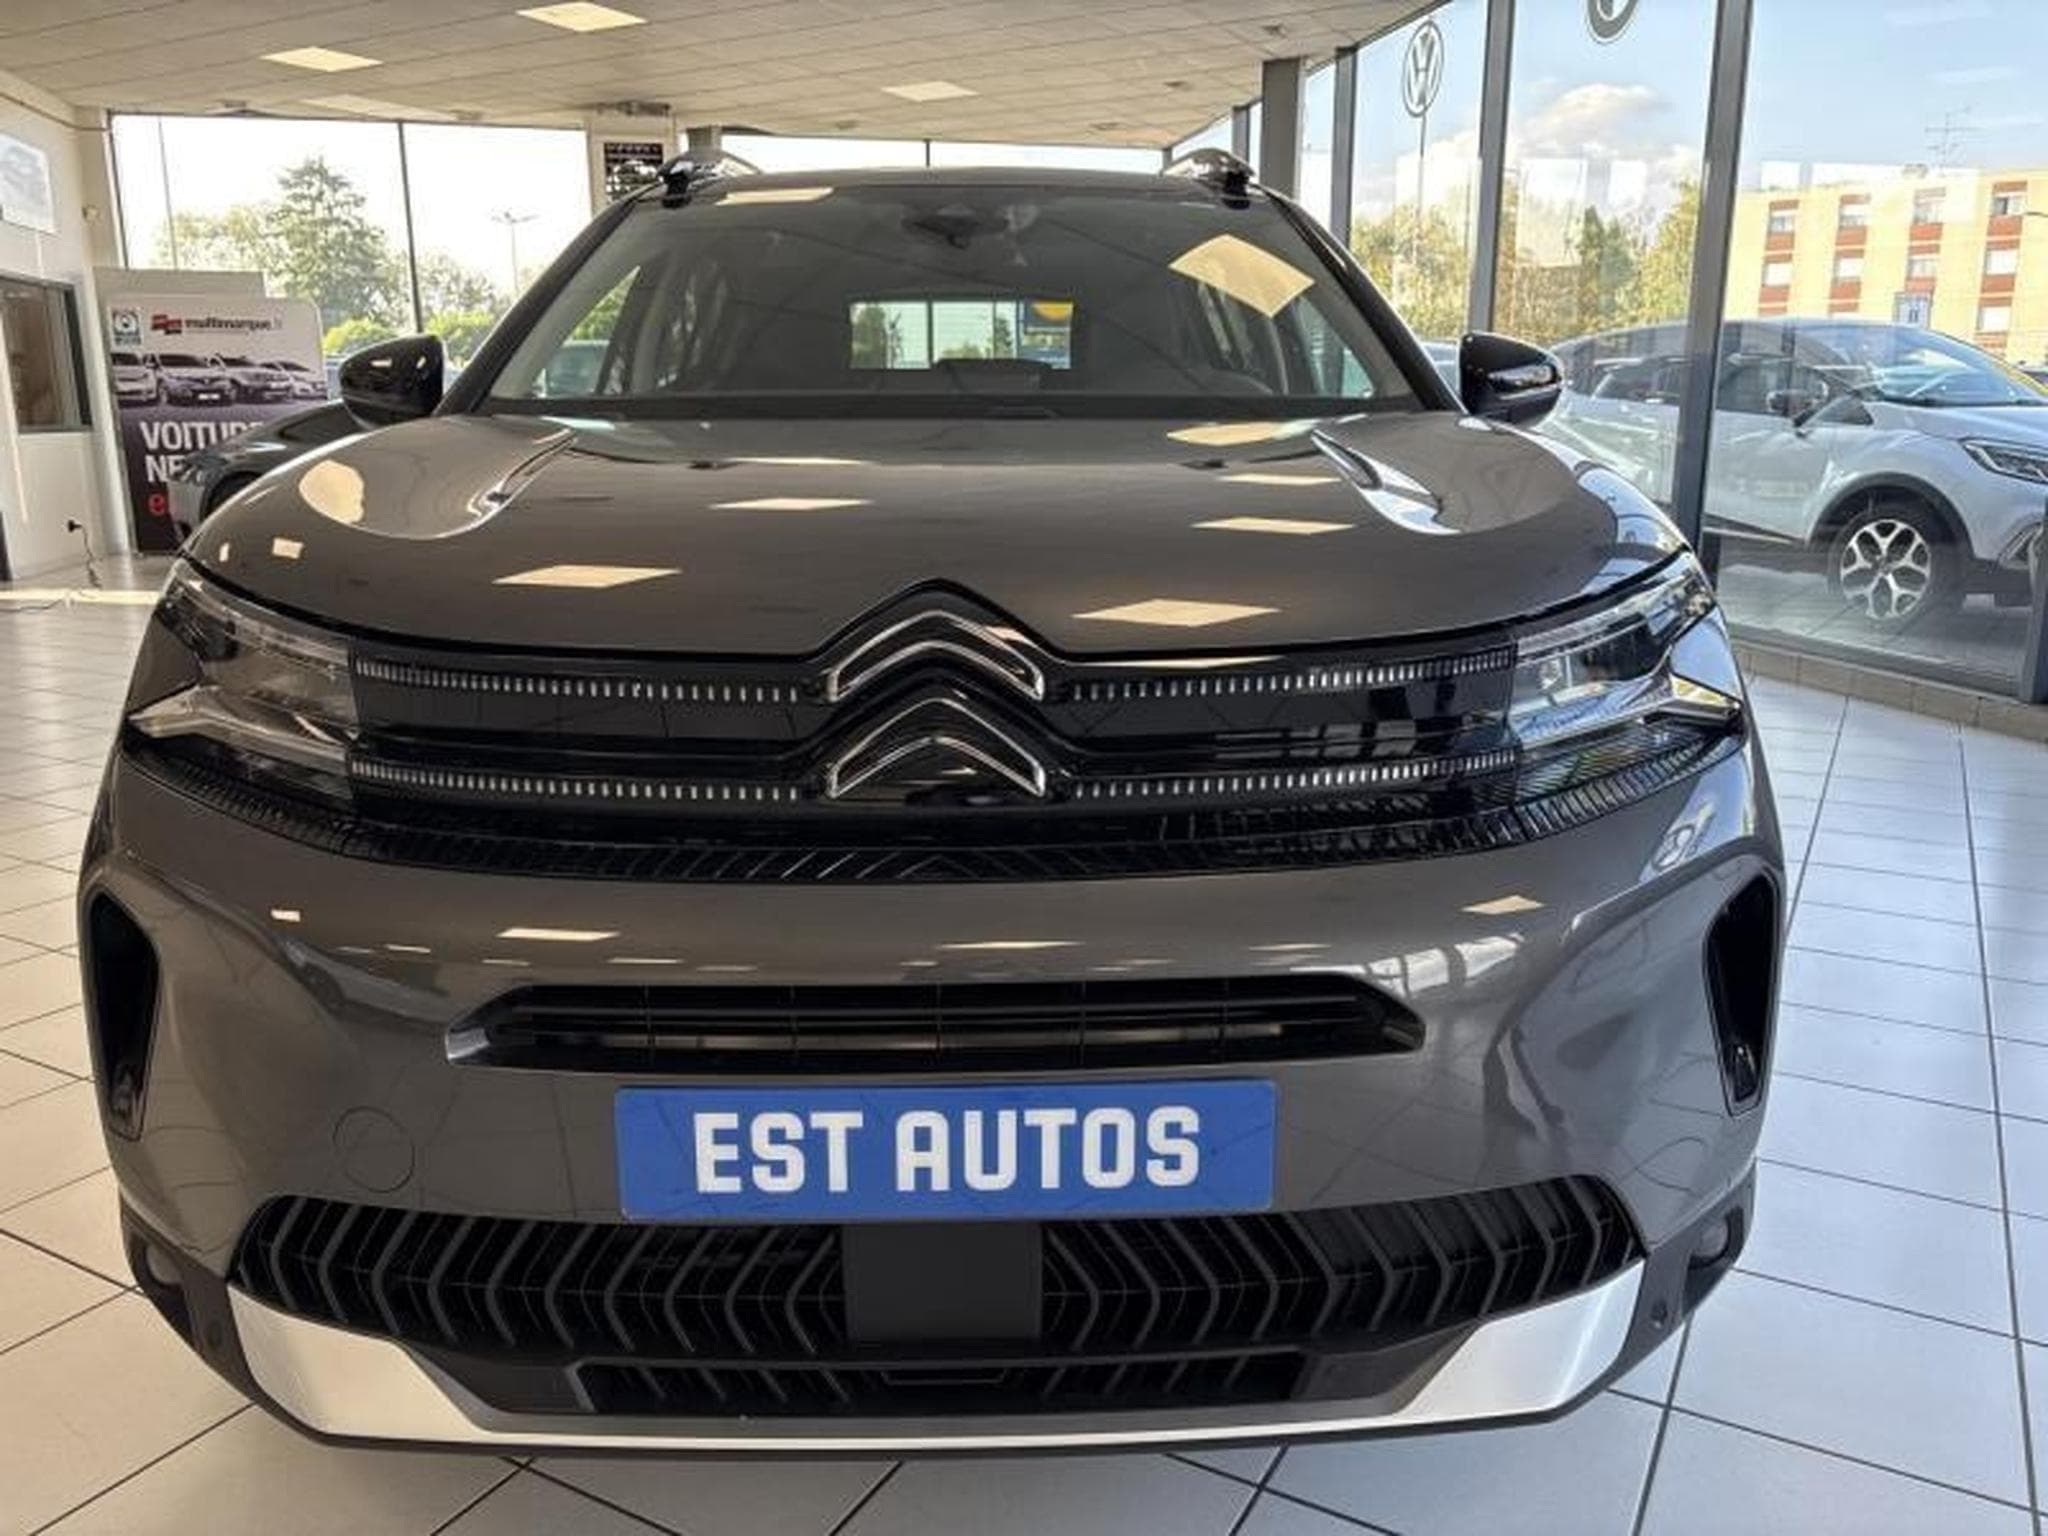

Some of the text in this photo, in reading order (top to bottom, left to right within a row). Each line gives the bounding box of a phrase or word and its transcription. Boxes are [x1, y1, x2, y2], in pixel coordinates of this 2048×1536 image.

[140, 421, 263, 450] VOITU
[694, 1106, 1200, 1193] EST AUTOS
